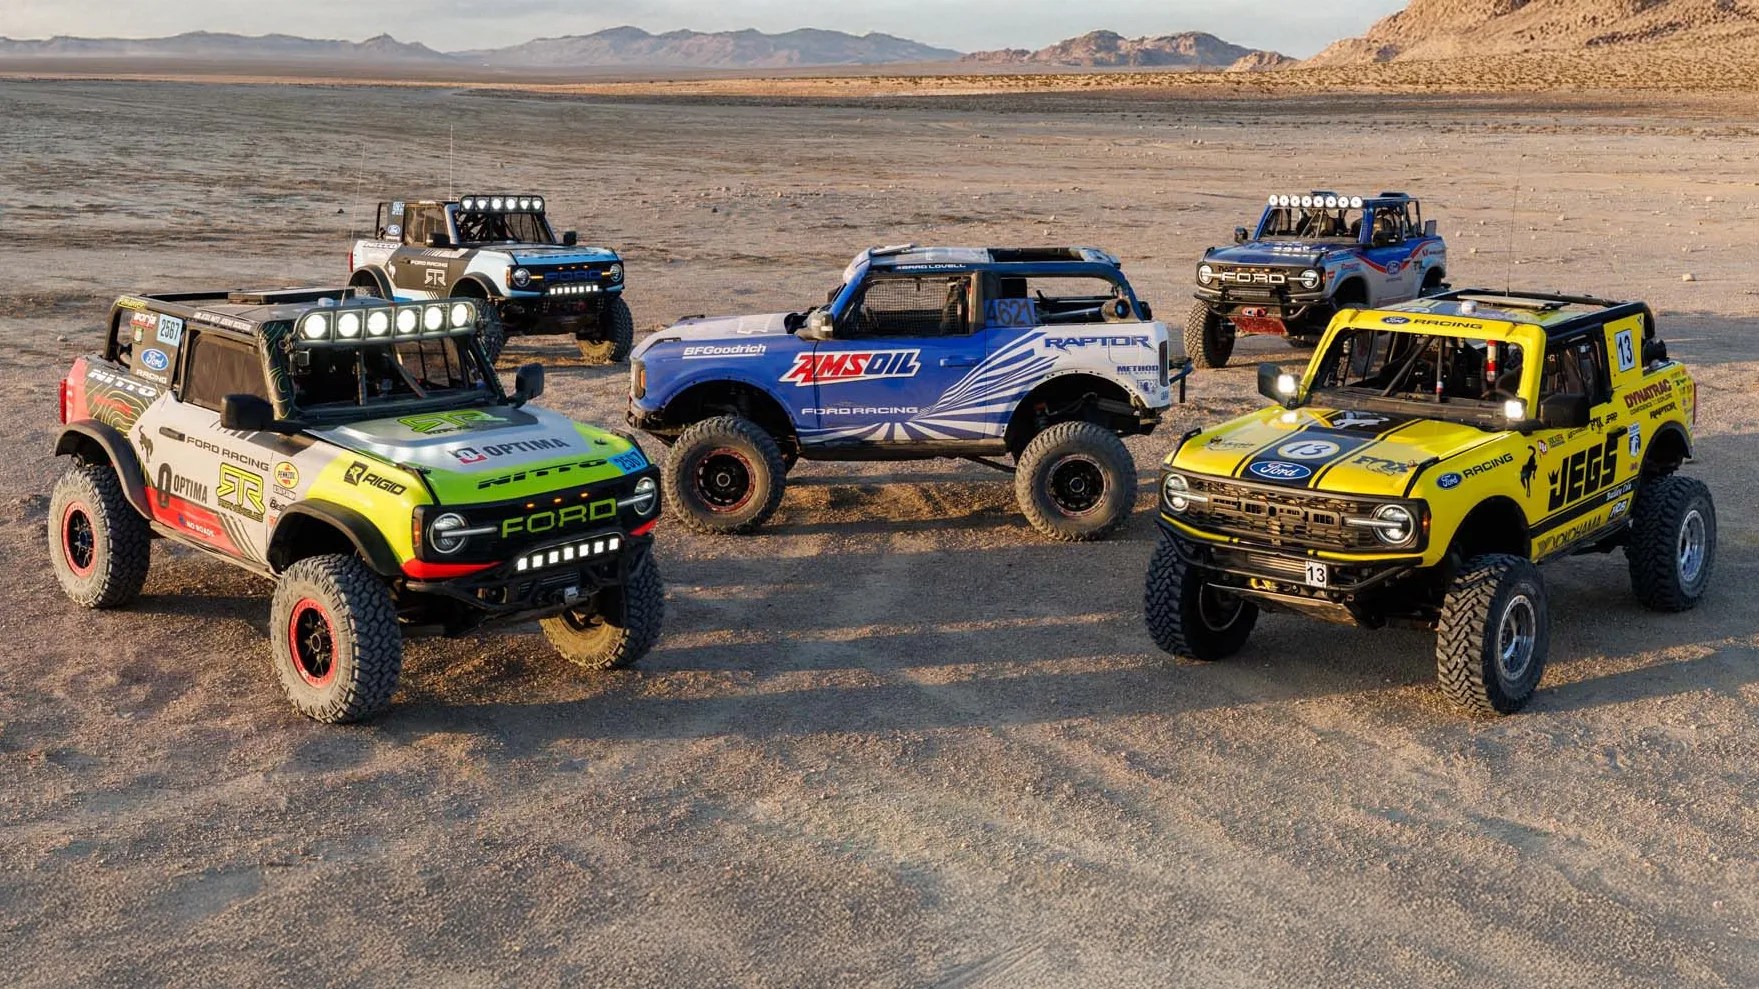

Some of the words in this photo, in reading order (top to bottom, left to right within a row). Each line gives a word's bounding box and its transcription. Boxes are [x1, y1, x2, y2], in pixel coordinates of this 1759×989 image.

[544, 270, 602, 282] FORD
[1221, 271, 1285, 284] FORD
[987, 300, 1034, 325] 4621
[160, 318, 180, 340] 2567
[1413, 318, 1483, 330] RACING
[683, 344, 767, 357] BFGoodrich
[1044, 335, 1157, 354] RAPTOR
[1618, 334, 1634, 366] 13
[135, 368, 168, 385] RACING
[787, 352, 917, 384] AMSOIL
[88, 369, 157, 397] NITTO
[1623, 378, 1673, 409] DYNATRAC
[801, 407, 851, 415] FORD
[1650, 401, 1679, 419] RAPTOR
[186, 436, 220, 454] FORD
[222, 447, 270, 472] RACING
[483, 438, 570, 457] OPTIMA
[1287, 442, 1331, 458] 13
[477, 458, 608, 490] NITTO
[1261, 462, 1297, 477] Ford
[1441, 473, 1460, 488] Ford
[1462, 452, 1515, 479] RACING
[1547, 442, 1619, 512] JEGS
[173, 474, 208, 504] OPTIMA
[216, 461, 266, 515] RTR
[362, 473, 408, 495] RIGID
[501, 498, 617, 538] FORD
[1307, 562, 1326, 584] 13
